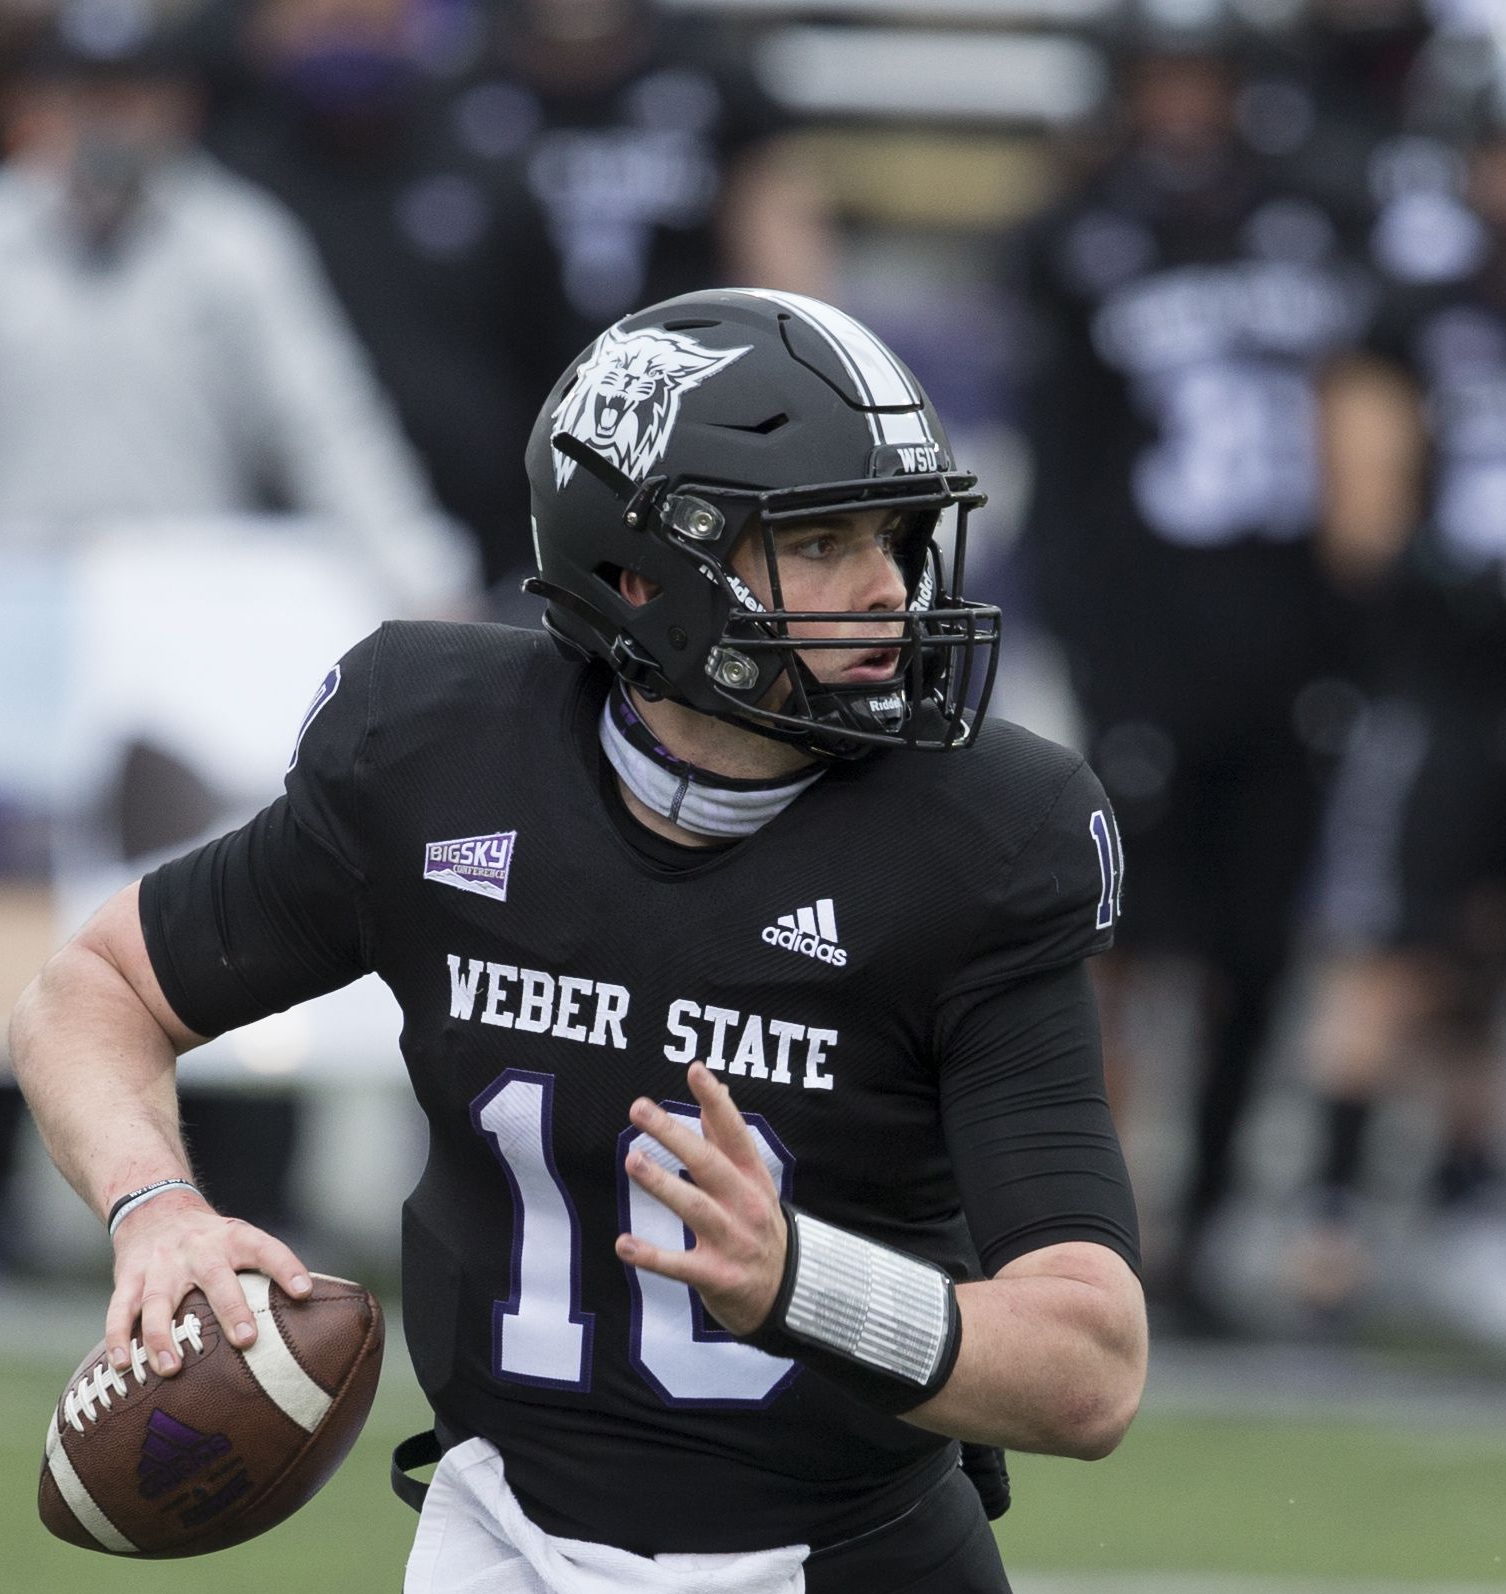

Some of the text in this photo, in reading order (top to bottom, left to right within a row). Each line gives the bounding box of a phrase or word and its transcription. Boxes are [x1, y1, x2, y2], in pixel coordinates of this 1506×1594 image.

[897, 447, 937, 473] WSU
[761, 926, 847, 967] adidas
[447, 954, 838, 1090] WEBER STATE
